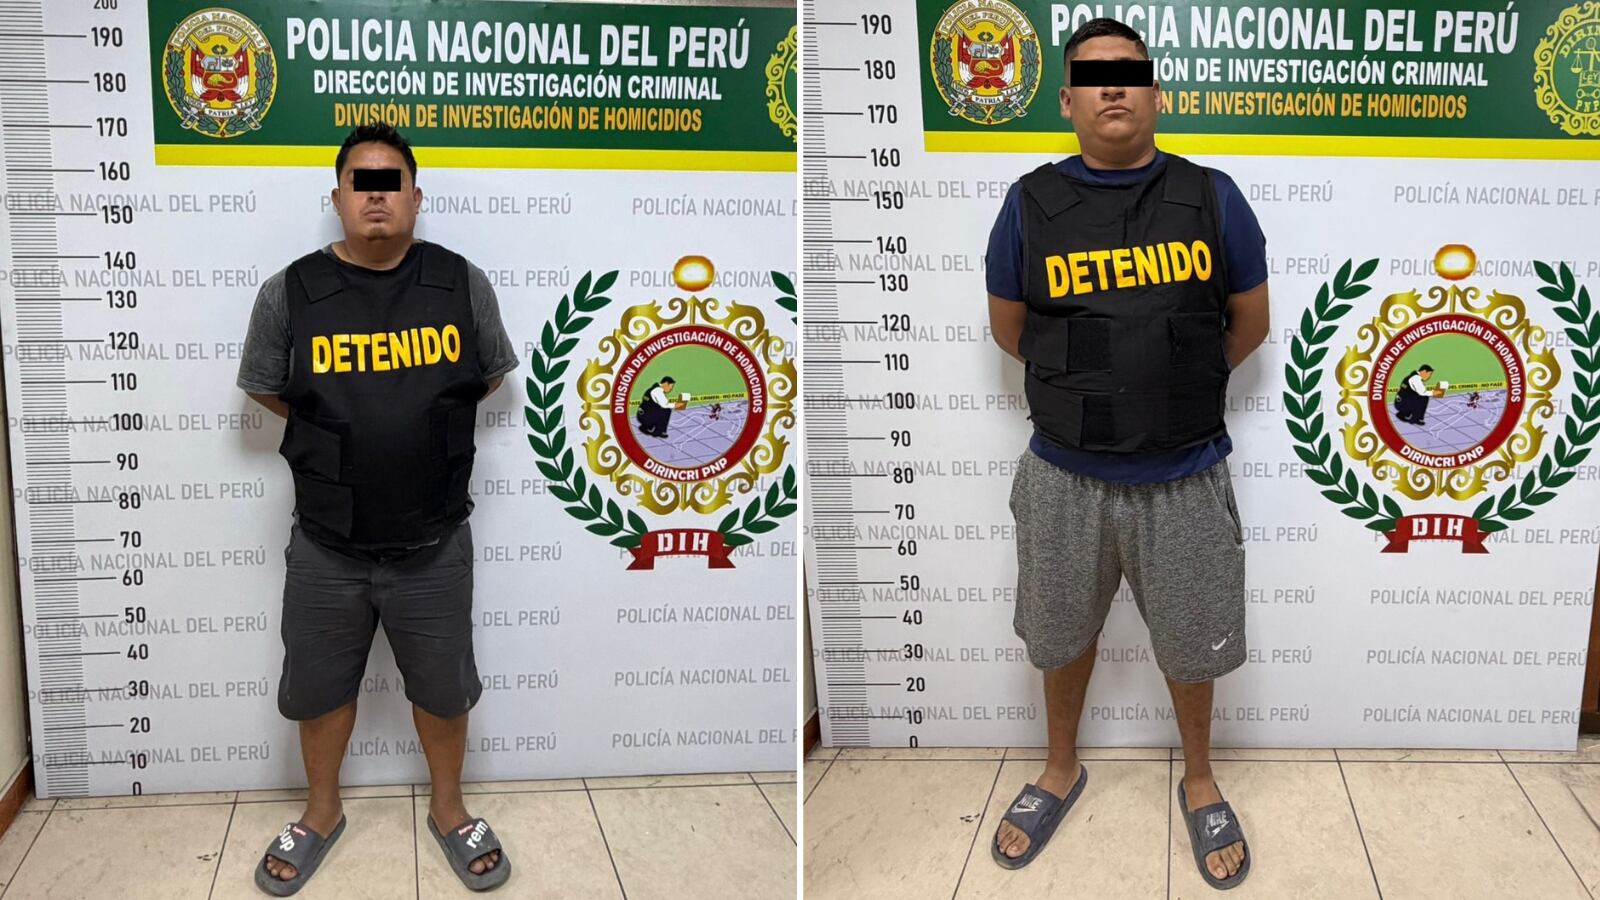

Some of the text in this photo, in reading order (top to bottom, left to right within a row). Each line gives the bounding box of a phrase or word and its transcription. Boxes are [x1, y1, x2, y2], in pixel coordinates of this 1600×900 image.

[861, 14, 892, 35] 190
[1191, 6, 1354, 50] NACIONAL
[1364, 9, 1423, 52] DEL
[1434, 2, 1520, 54] PERÚ
[91, 27, 123, 47] 190
[286, 17, 750, 69] POLICIA NACIONAL DEL PERÚ
[864, 60, 896, 80] 180
[1196, 58, 1222, 82] DE
[1229, 55, 1385, 84] INVESTIGACIÓN
[1392, 61, 1488, 87] CRIMINAL
[94, 73, 126, 92] 180
[314, 65, 722, 101] DIRECCIÓN DE INVESTIGACIÓN CRIMINAL
[1178, 91, 1200, 115] DE
[1206, 88, 1336, 117] INVESTIGACIÓN
[1341, 93, 1362, 117] DE
[1368, 94, 1467, 119] HOMICIDIOS
[335, 98, 702, 132] DIVISIÓN DE INVESTIGACIÓN DE HOMICIDIOS
[867, 105, 898, 124] 170
[96, 117, 128, 137] 170
[870, 148, 900, 167] 160
[99, 161, 130, 181] 160
[873, 191, 904, 209] 150
[1288, 180, 1333, 202] PERÚ
[1394, 182, 1550, 205] POLICÍA NACIONAL
[209, 190, 257, 213] PERÚ
[527, 192, 572, 214] PERÚ
[632, 194, 697, 215] POLICÍA
[703, 198, 786, 216] NACIONAL
[101, 205, 133, 224] 150
[877, 236, 907, 254] 140
[104, 251, 136, 270] 140
[849, 254, 936, 272] NACIONAL
[941, 254, 974, 272] DEL
[1045, 239, 1213, 299] DETENIDO
[1285, 253, 1330, 274] PERÚ
[75, 265, 259, 287] NACIONAL PERÚ
[525, 265, 570, 287] PERÚ
[879, 274, 909, 292] 130
[106, 290, 137, 308] 130
[882, 314, 910, 332] 120
[108, 332, 139, 350] 120
[312, 324, 461, 374] DETENIDO
[885, 353, 909, 371] 110
[1372, 355, 1394, 400] DIVISIÓN
[1390, 340, 1405, 356] DE
[1403, 320, 1484, 344] INVESTIGACIÓN
[1482, 330, 1498, 344] DE
[1494, 342, 1521, 402] HOMICIDIOS
[110, 372, 137, 391] 110
[614, 369, 636, 414] DIVISIÓN
[631, 351, 647, 368] DE
[644, 331, 726, 356] INVESTIGACIÓN
[723, 341, 737, 356] DE
[735, 352, 763, 413] HOMICIDIOS
[887, 392, 915, 409] 100
[112, 412, 143, 431] 100
[217, 409, 263, 430] PERÚ
[891, 430, 911, 447] 90
[116, 453, 138, 471] 90
[1400, 445, 1485, 467] DIRINCRI PNP
[643, 457, 728, 481] DIRINCRI PNP
[893, 468, 914, 484] 80
[182, 477, 265, 500] DEL PERÚ
[119, 492, 141, 509] 80
[895, 504, 915, 520] 70
[868, 525, 950, 540] NACIONAL
[1276, 523, 1318, 542] PERÚ
[1412, 518, 1464, 537] DIH
[1525, 528, 1555, 544] DEL
[120, 531, 142, 548] 70
[657, 532, 709, 552] DIH
[898, 540, 917, 556] 60
[91, 546, 266, 571] NACIONAL PERÚ
[483, 541, 562, 562] DEL PERÚ
[122, 569, 143, 586] 60
[900, 575, 920, 591] 50
[1274, 585, 1315, 604] PERÚ
[1370, 587, 1594, 606] POLICÍA NACIONAL PERÚ
[125, 606, 146, 623] 50
[186, 612, 268, 633] DEL PERÚ
[518, 606, 560, 626] PERÚ
[616, 603, 761, 623] POLICÍA NACIONAL
[902, 610, 922, 625] 40
[127, 643, 149, 660] 40
[903, 644, 924, 659] 30
[1271, 645, 1312, 664] PERÚ
[1367, 646, 1426, 665] POLICÍA
[1431, 650, 1508, 665] NACIONAL
[1513, 651, 1542, 666] DEL
[517, 670, 558, 689] PERÚ
[614, 667, 791, 686] POLICÍA NACIONAL DEL
[906, 677, 925, 692] 20
[128, 680, 149, 697] 30
[226, 677, 269, 697] PERÚ
[906, 710, 923, 725] 10
[962, 703, 1036, 720] DEL PERÚ
[1091, 703, 1310, 722] POLICÍA DEL PERÚ
[1363, 705, 1503, 723] POLICÍA NACIONAL
[130, 717, 150, 733] 20
[481, 732, 557, 752] DEL PERÚ
[611, 728, 753, 748] POLICÍA NACIONAL
[909, 736, 918, 748] 0
[129, 753, 147, 770] 10
[190, 741, 270, 763] DEL PERÚ
[132, 781, 142, 796] 0
[466, 820, 489, 849] rem
